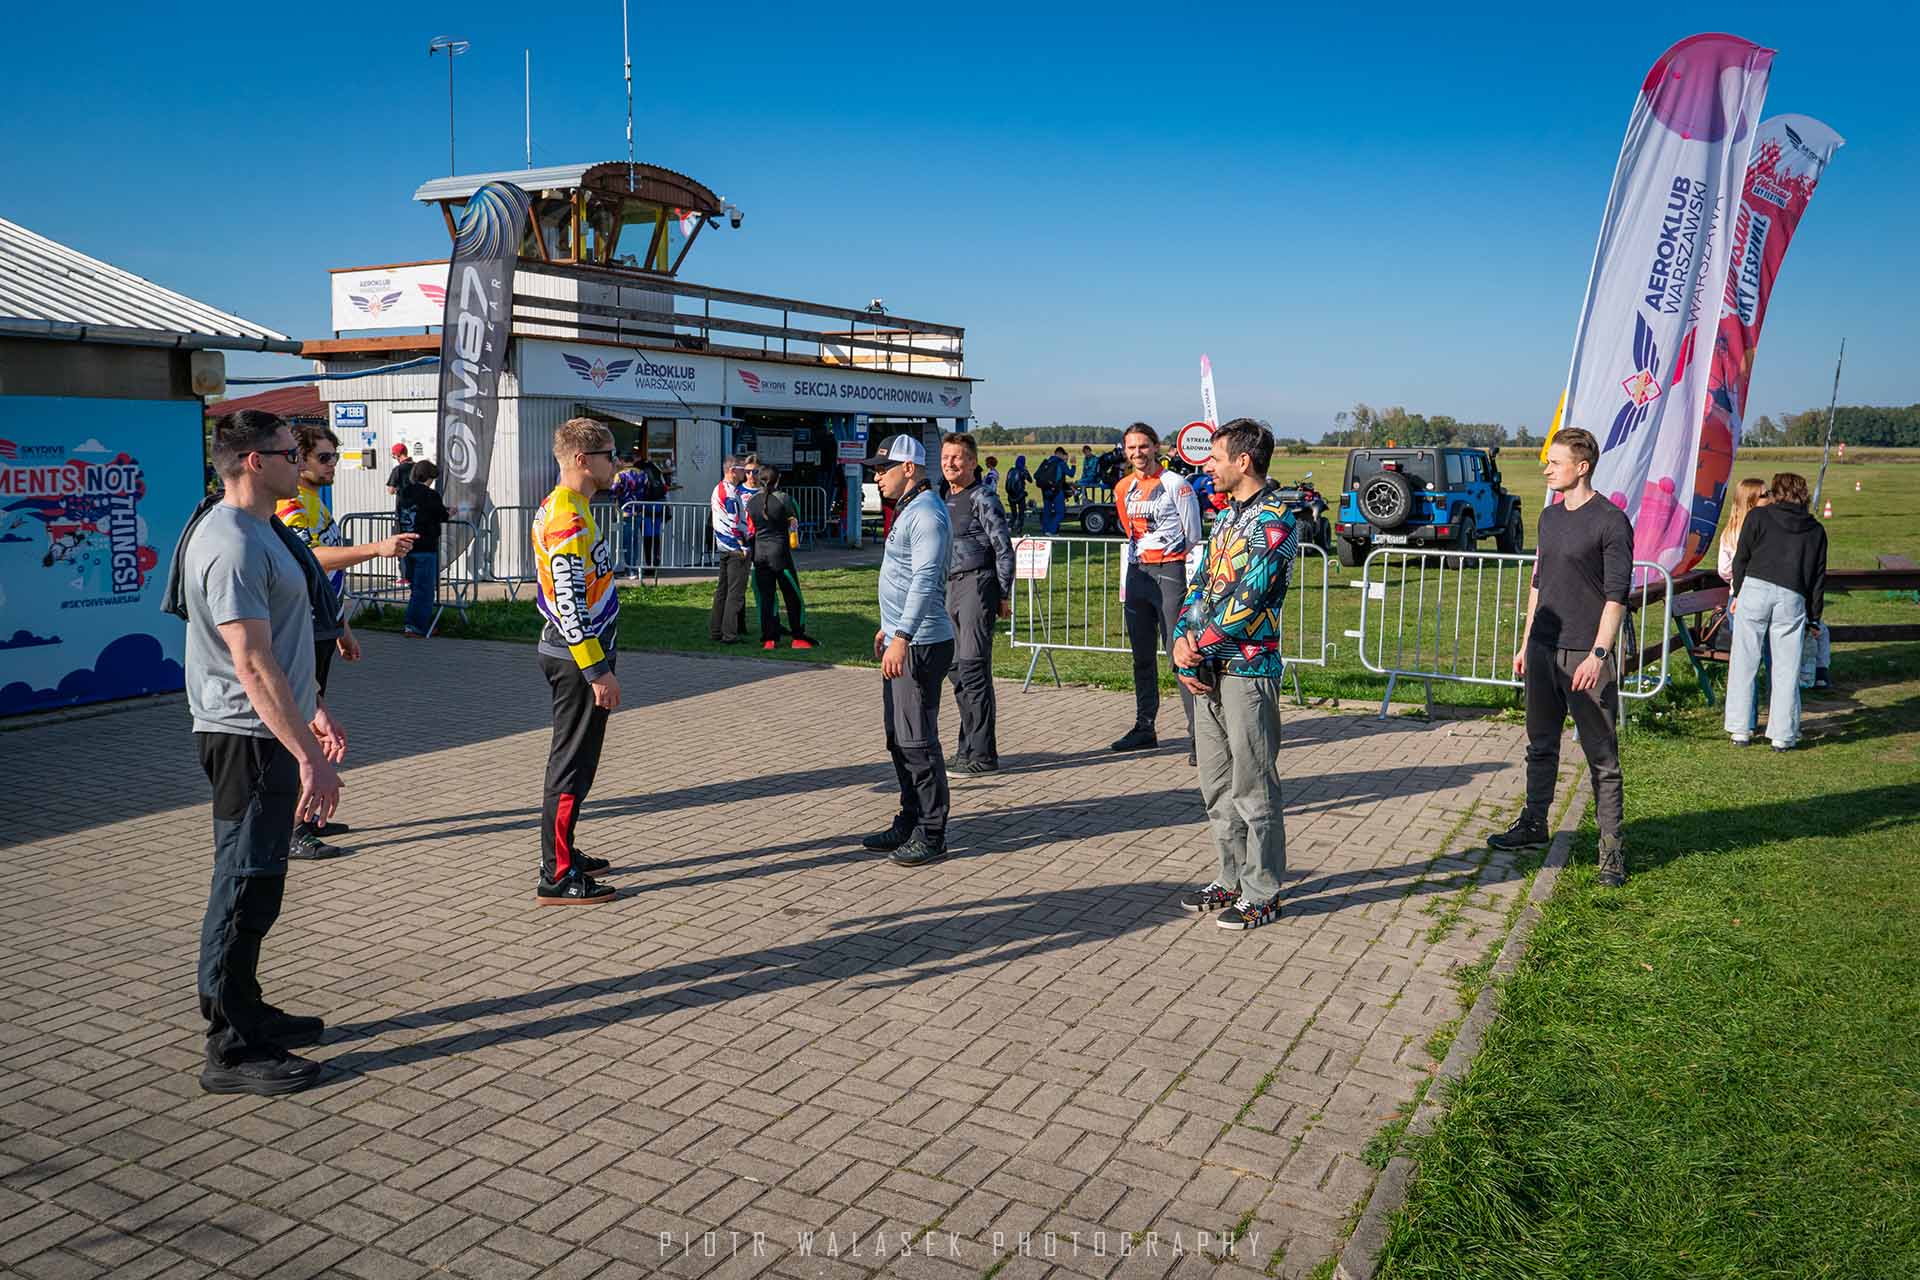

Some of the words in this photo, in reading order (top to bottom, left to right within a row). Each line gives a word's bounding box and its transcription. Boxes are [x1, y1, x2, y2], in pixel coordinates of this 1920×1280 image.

[1645, 176, 1691, 312] AEROKLUB
[1664, 181, 1707, 314] WARSZAWSKI
[1742, 215, 1768, 288] FESTIVAL
[1737, 288, 1755, 322] SKY
[476, 278, 502, 419] FLYWEAR
[635, 363, 696, 380] AEROKLUB
[635, 377, 696, 392] WARSZAWSKI
[794, 381, 838, 398] SEKCJA
[839, 384, 934, 405] SPADOCHRONOWA
[21, 446, 65, 455] SKYDIVE
[87, 467, 136, 491] NOT
[110, 495, 139, 593] THINGS!
[571, 556, 586, 592] LIMIT
[61, 595, 141, 609] #SKYDIVEWARSAW
[552, 556, 582, 644] GROUND
[577, 596, 590, 622] THE
[582, 625, 593, 636] IS
